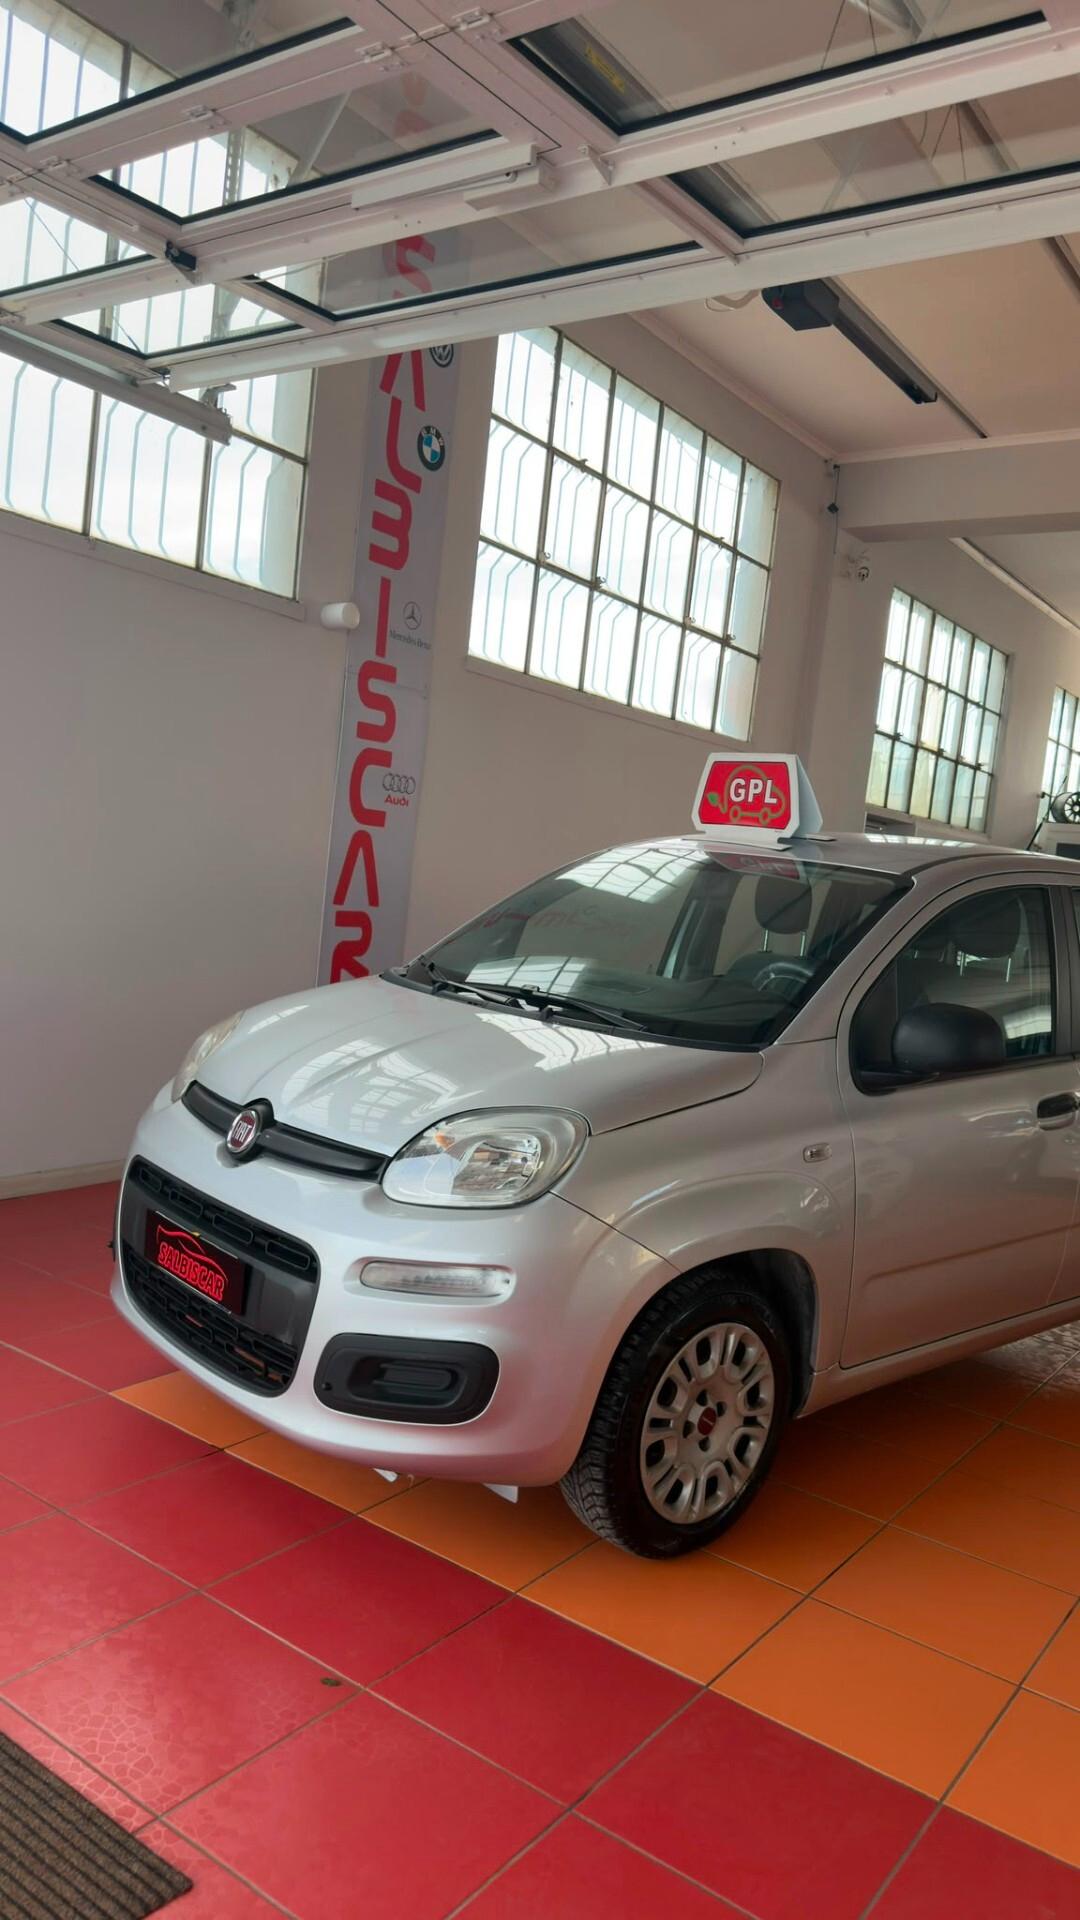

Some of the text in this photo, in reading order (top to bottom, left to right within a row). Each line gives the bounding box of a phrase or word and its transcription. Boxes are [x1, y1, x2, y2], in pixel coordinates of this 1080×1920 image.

[384, 794, 409, 807] Audi
[729, 777, 778, 804] GPL
[231, 1120, 253, 1143] FIAT
[158, 1241, 225, 1302] SALBISCAR
